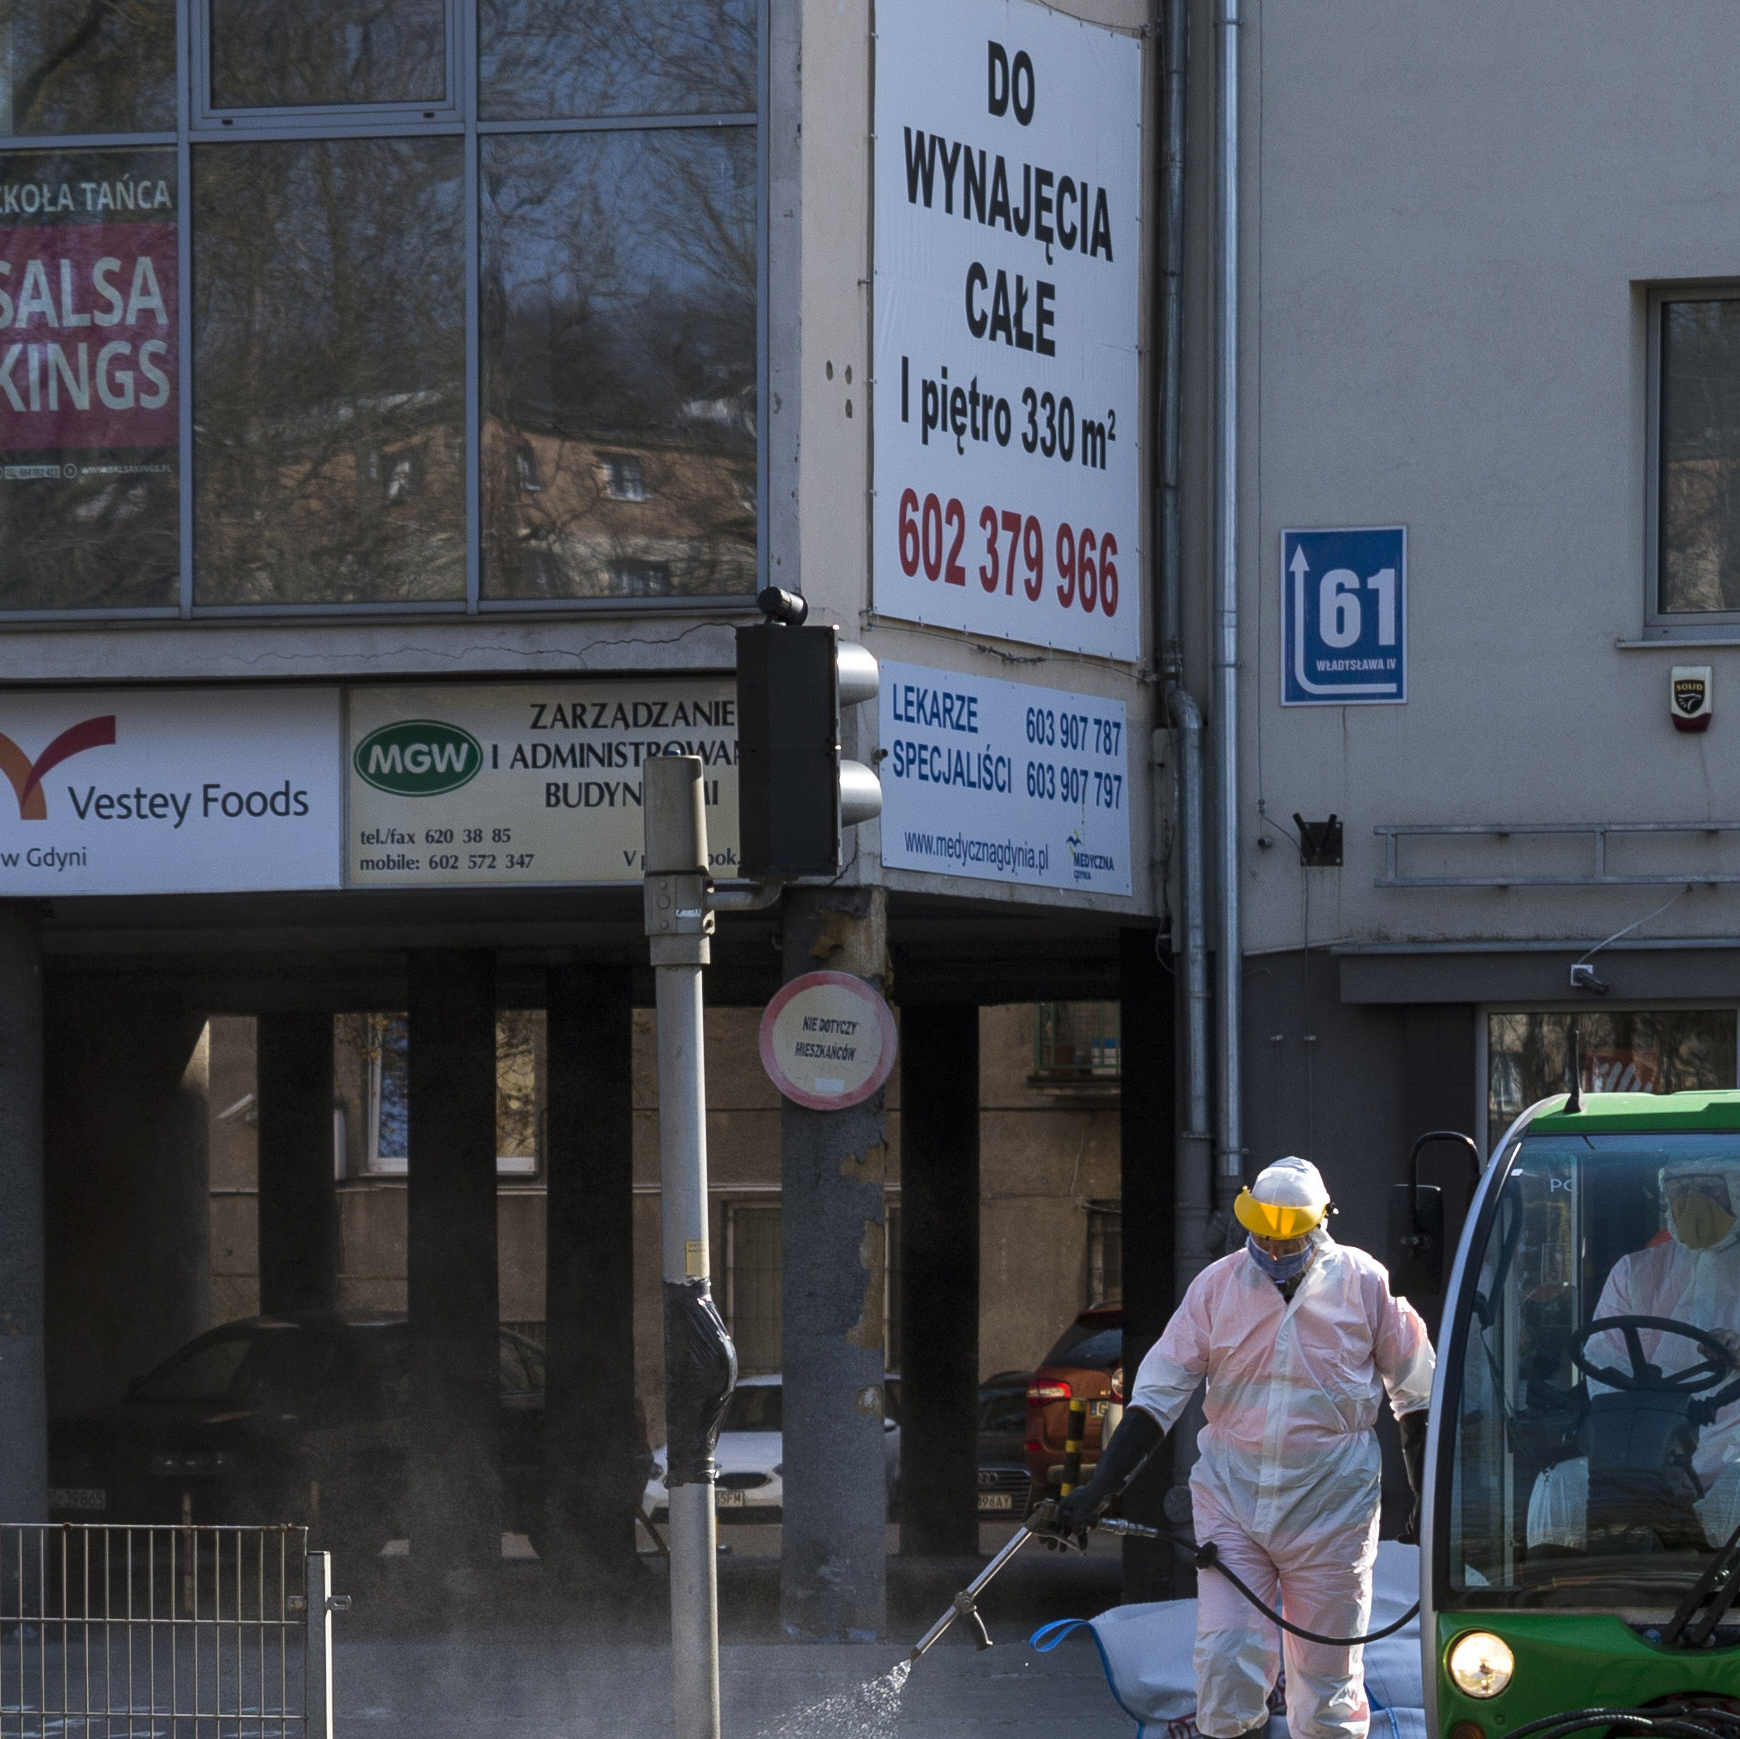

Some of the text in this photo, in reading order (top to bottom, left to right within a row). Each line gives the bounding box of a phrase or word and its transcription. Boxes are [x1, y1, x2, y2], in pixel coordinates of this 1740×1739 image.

[987, 41, 1036, 127] DO
[80, 173, 173, 210] TAŃCA
[904, 126, 1114, 265] WYNAJĘCIA
[965, 261, 1057, 357] CAŁE
[901, 356, 909, 423] I
[921, 371, 1012, 455] piętro
[1021, 386, 1076, 463] 330
[898, 487, 1119, 618] 602 379 966
[1319, 568, 1396, 649] 61
[1316, 657, 1397, 672] WŁADYSŁAWA IV
[529, 700, 735, 732] ZARZĄDZANIE
[892, 683, 1122, 757] LEKARZE 603 907 787
[367, 743, 469, 774] MGW
[491, 743, 500, 769] I
[892, 739, 1122, 809] SPECJALIŚCI 603 907 797
[67, 781, 310, 830] Vestey Foods
[360, 828, 512, 846] tel./fax 620 38 85
[904, 831, 1049, 876] www.medycznagdynia.pl
[0, 854, 21, 870] w
[25, 847, 88, 875] Gdyni
[360, 853, 535, 871] mobile: 602 572 347
[1073, 852, 1115, 872] MEDYCZNA
[802, 1016, 858, 1036] NIE DOTYCZY
